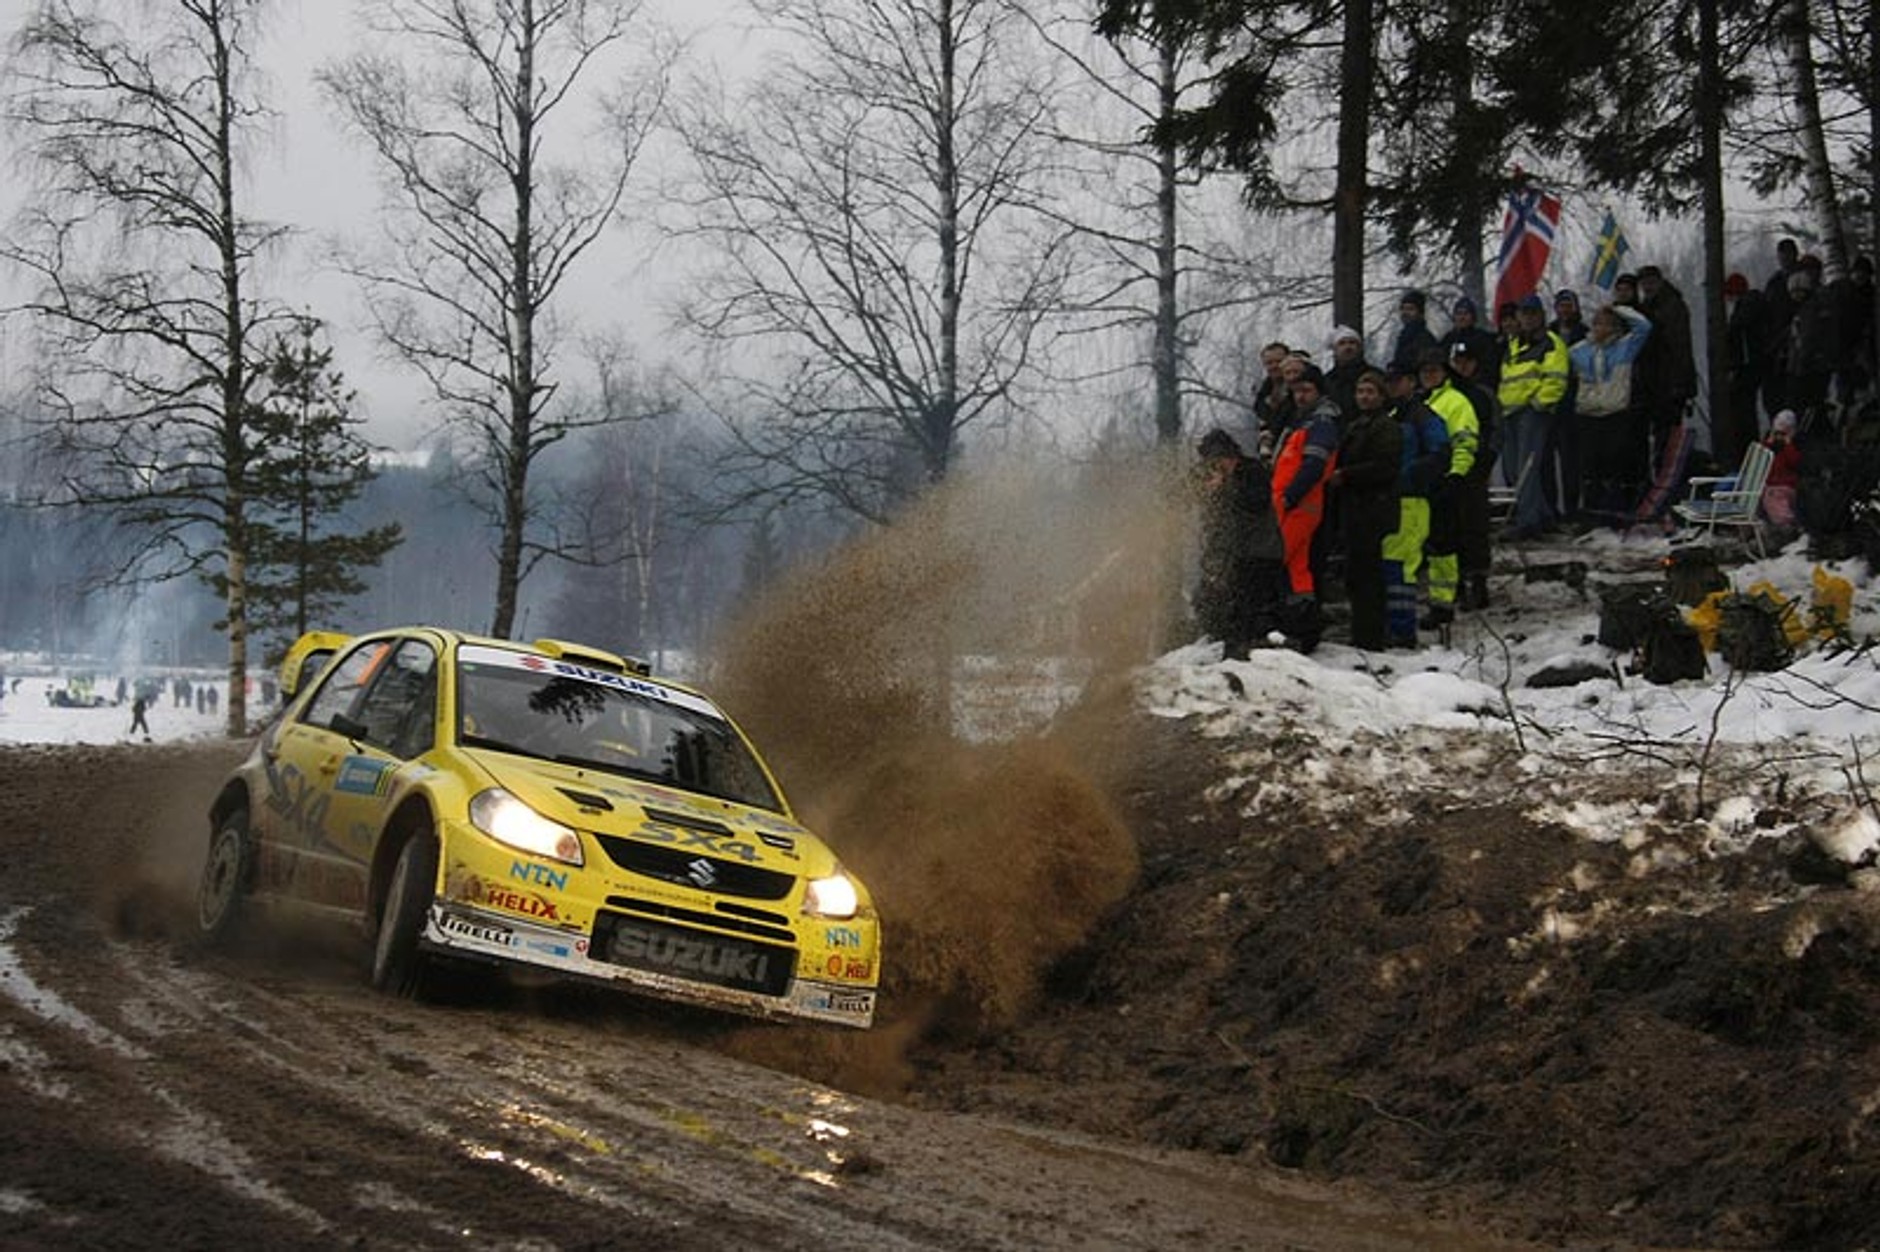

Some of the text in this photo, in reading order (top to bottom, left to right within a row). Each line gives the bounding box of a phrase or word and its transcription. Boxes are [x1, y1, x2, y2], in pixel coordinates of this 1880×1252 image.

[554, 663, 669, 698] SUZUKI
[510, 861, 567, 891] NTN
[486, 888, 560, 921] HELIX
[614, 926, 769, 982] SUZUKI
[826, 928, 861, 948] NTN
